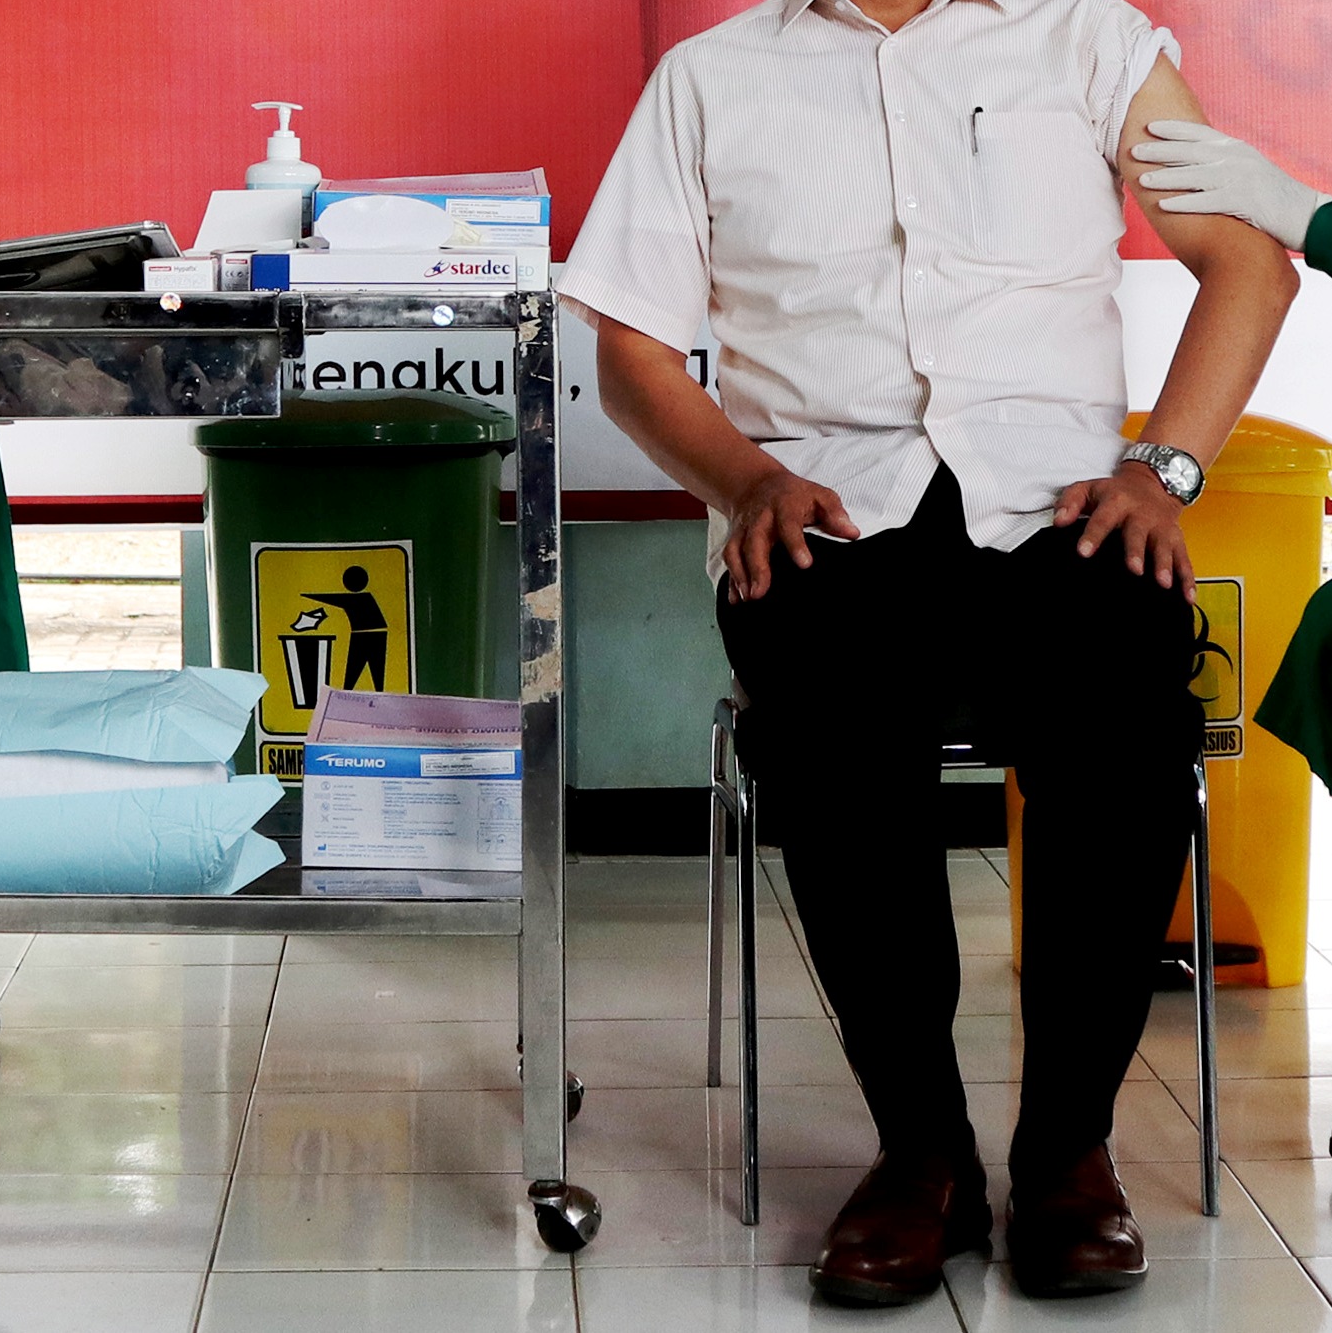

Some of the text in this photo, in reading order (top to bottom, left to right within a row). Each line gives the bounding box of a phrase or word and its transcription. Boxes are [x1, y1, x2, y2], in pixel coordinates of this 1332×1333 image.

[450, 260, 510, 275] stardec
[518, 266, 534, 277] ED
[268, 748, 304, 775] SAMP
[327, 757, 386, 769] TERUMO
